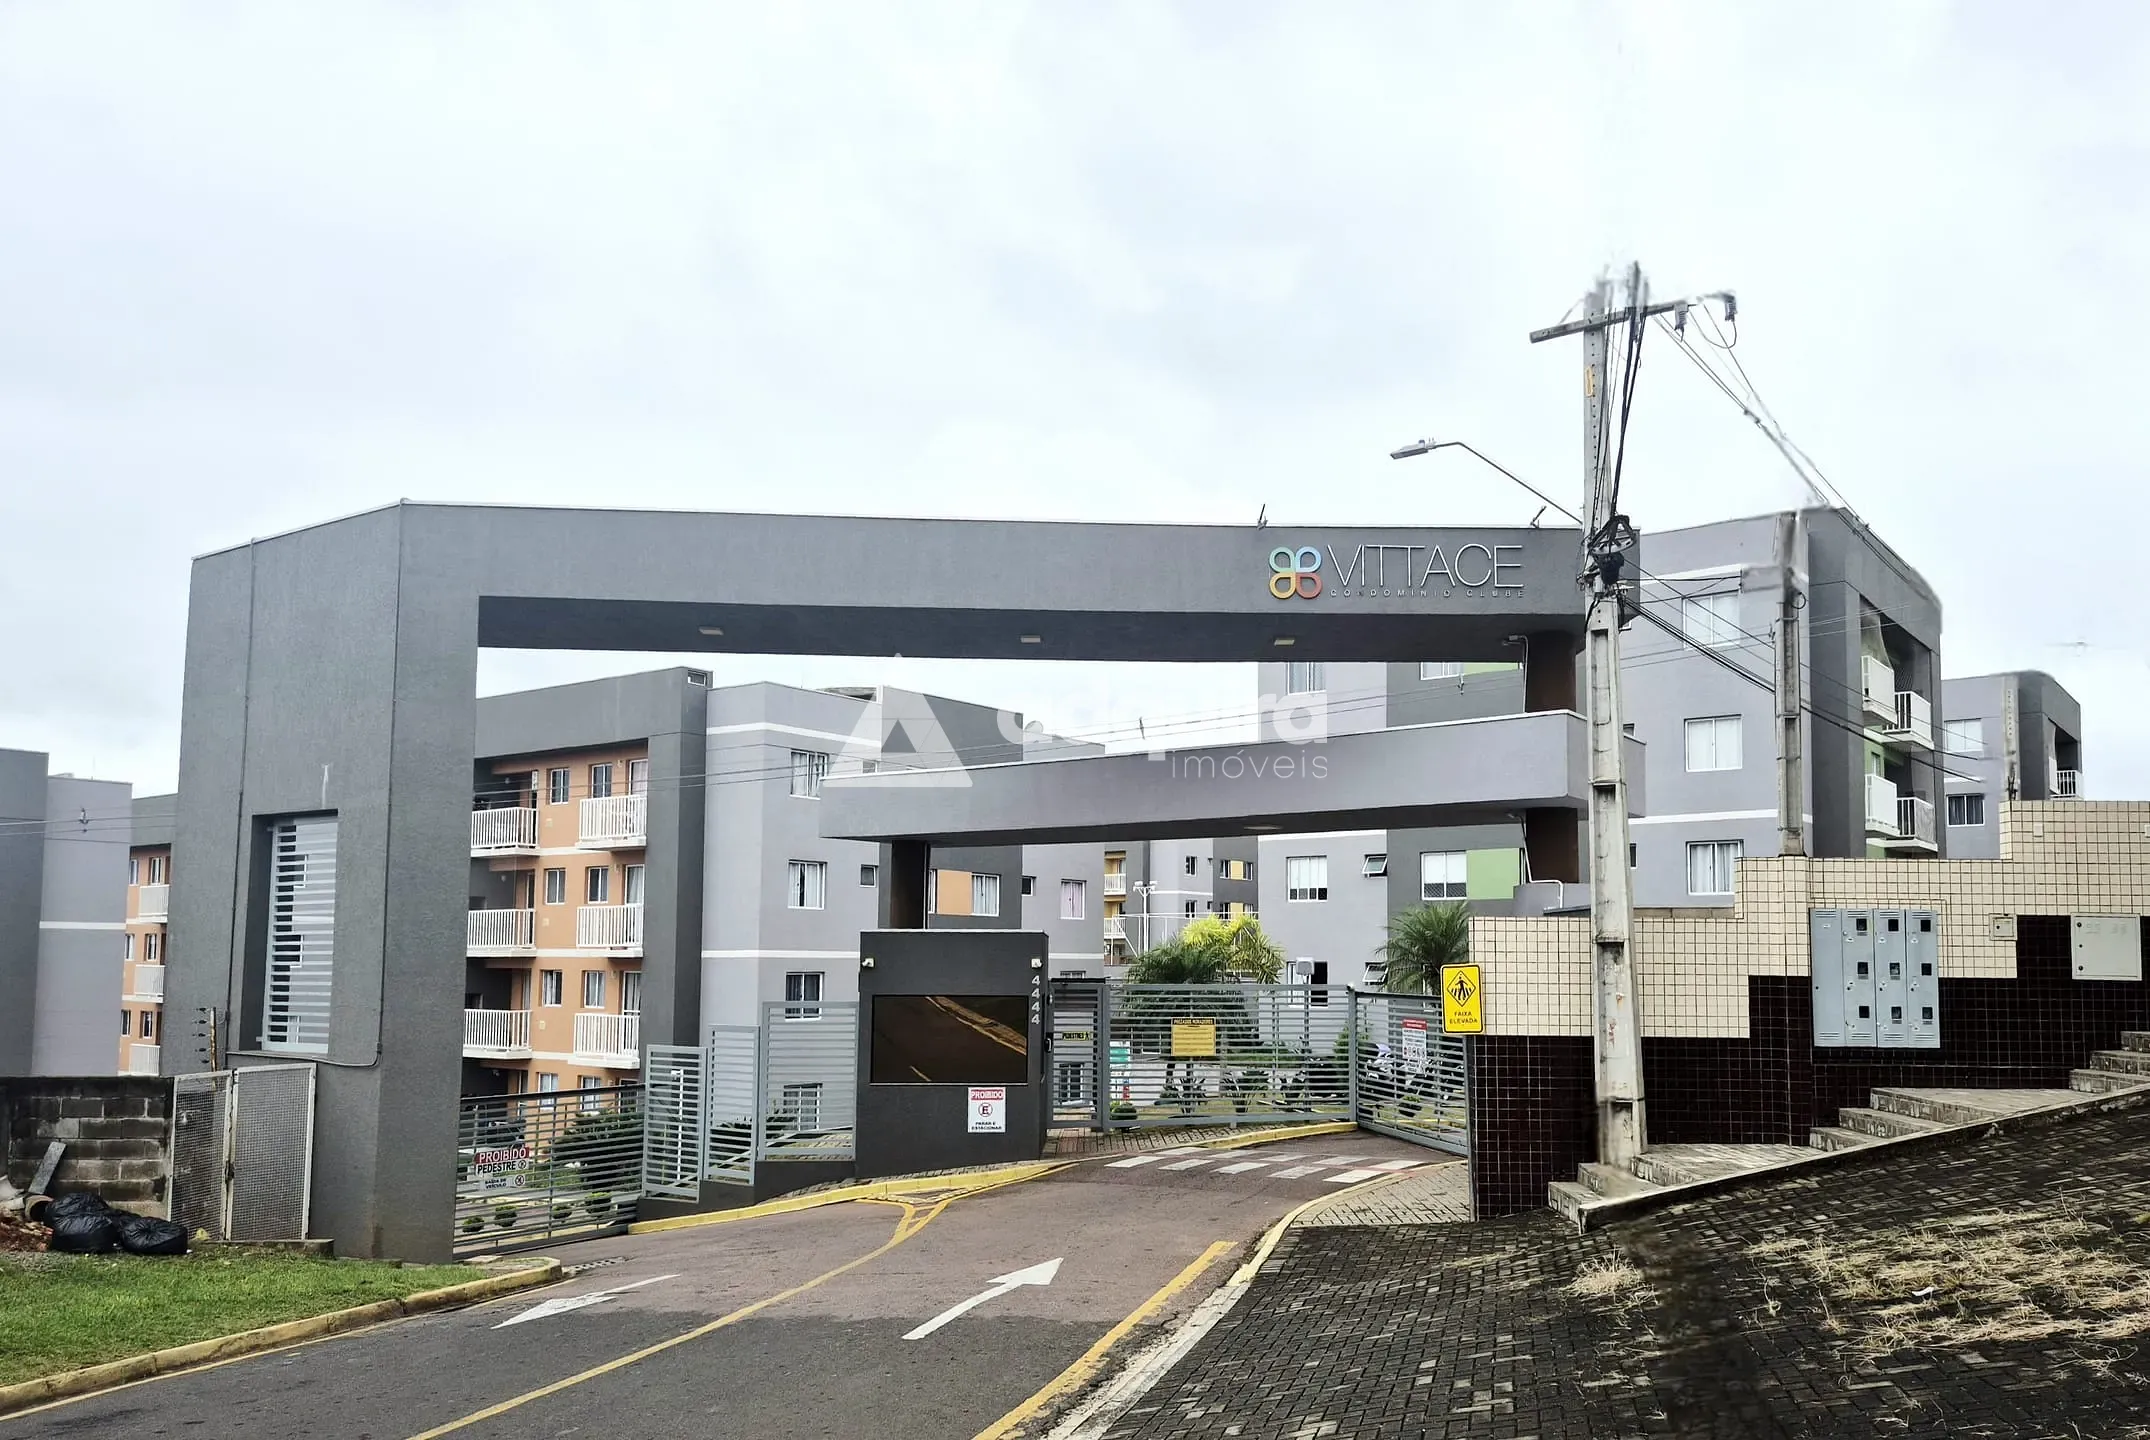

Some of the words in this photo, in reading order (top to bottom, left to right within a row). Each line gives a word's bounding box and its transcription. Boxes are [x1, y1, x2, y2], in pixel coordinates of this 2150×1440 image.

[1327, 543, 1525, 588] VITTACE
[971, 1090, 1003, 1099] PROIBIDO
[479, 1147, 527, 1164] PROIBIDO
[477, 1160, 517, 1174] PEDESTRE
